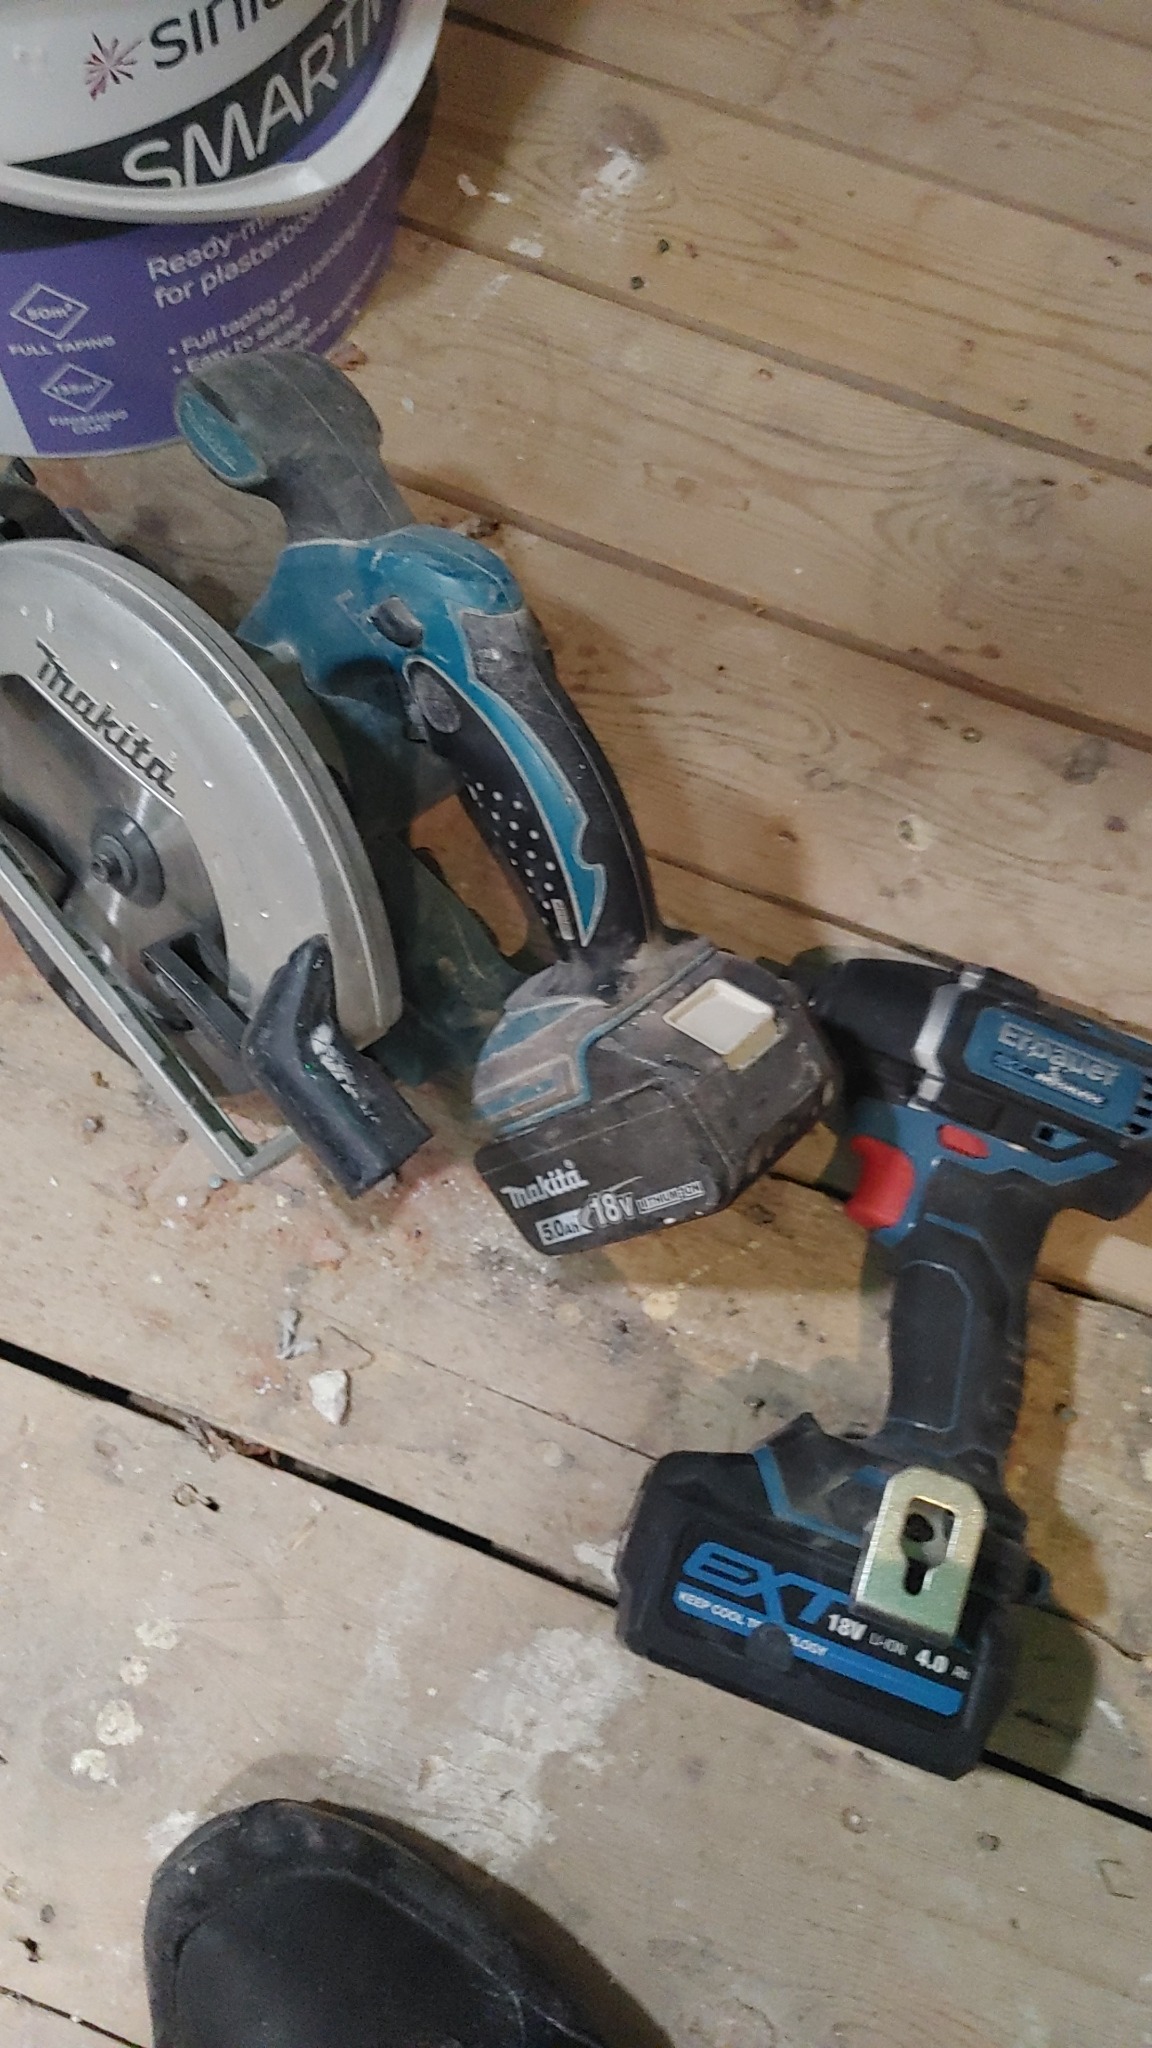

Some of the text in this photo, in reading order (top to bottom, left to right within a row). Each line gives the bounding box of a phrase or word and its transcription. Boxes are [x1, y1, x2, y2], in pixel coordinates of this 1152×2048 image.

[154, 280, 195, 308] for
[8, 335, 117, 356] FULL TAPING
[181, 327, 218, 355] Full
[682, 1541, 852, 1624] EXT
[678, 1591, 711, 1610] KEEP
[710, 1604, 746, 1626] COOL
[828, 1613, 868, 1641] 18V
[914, 1648, 950, 1673] 4.0
